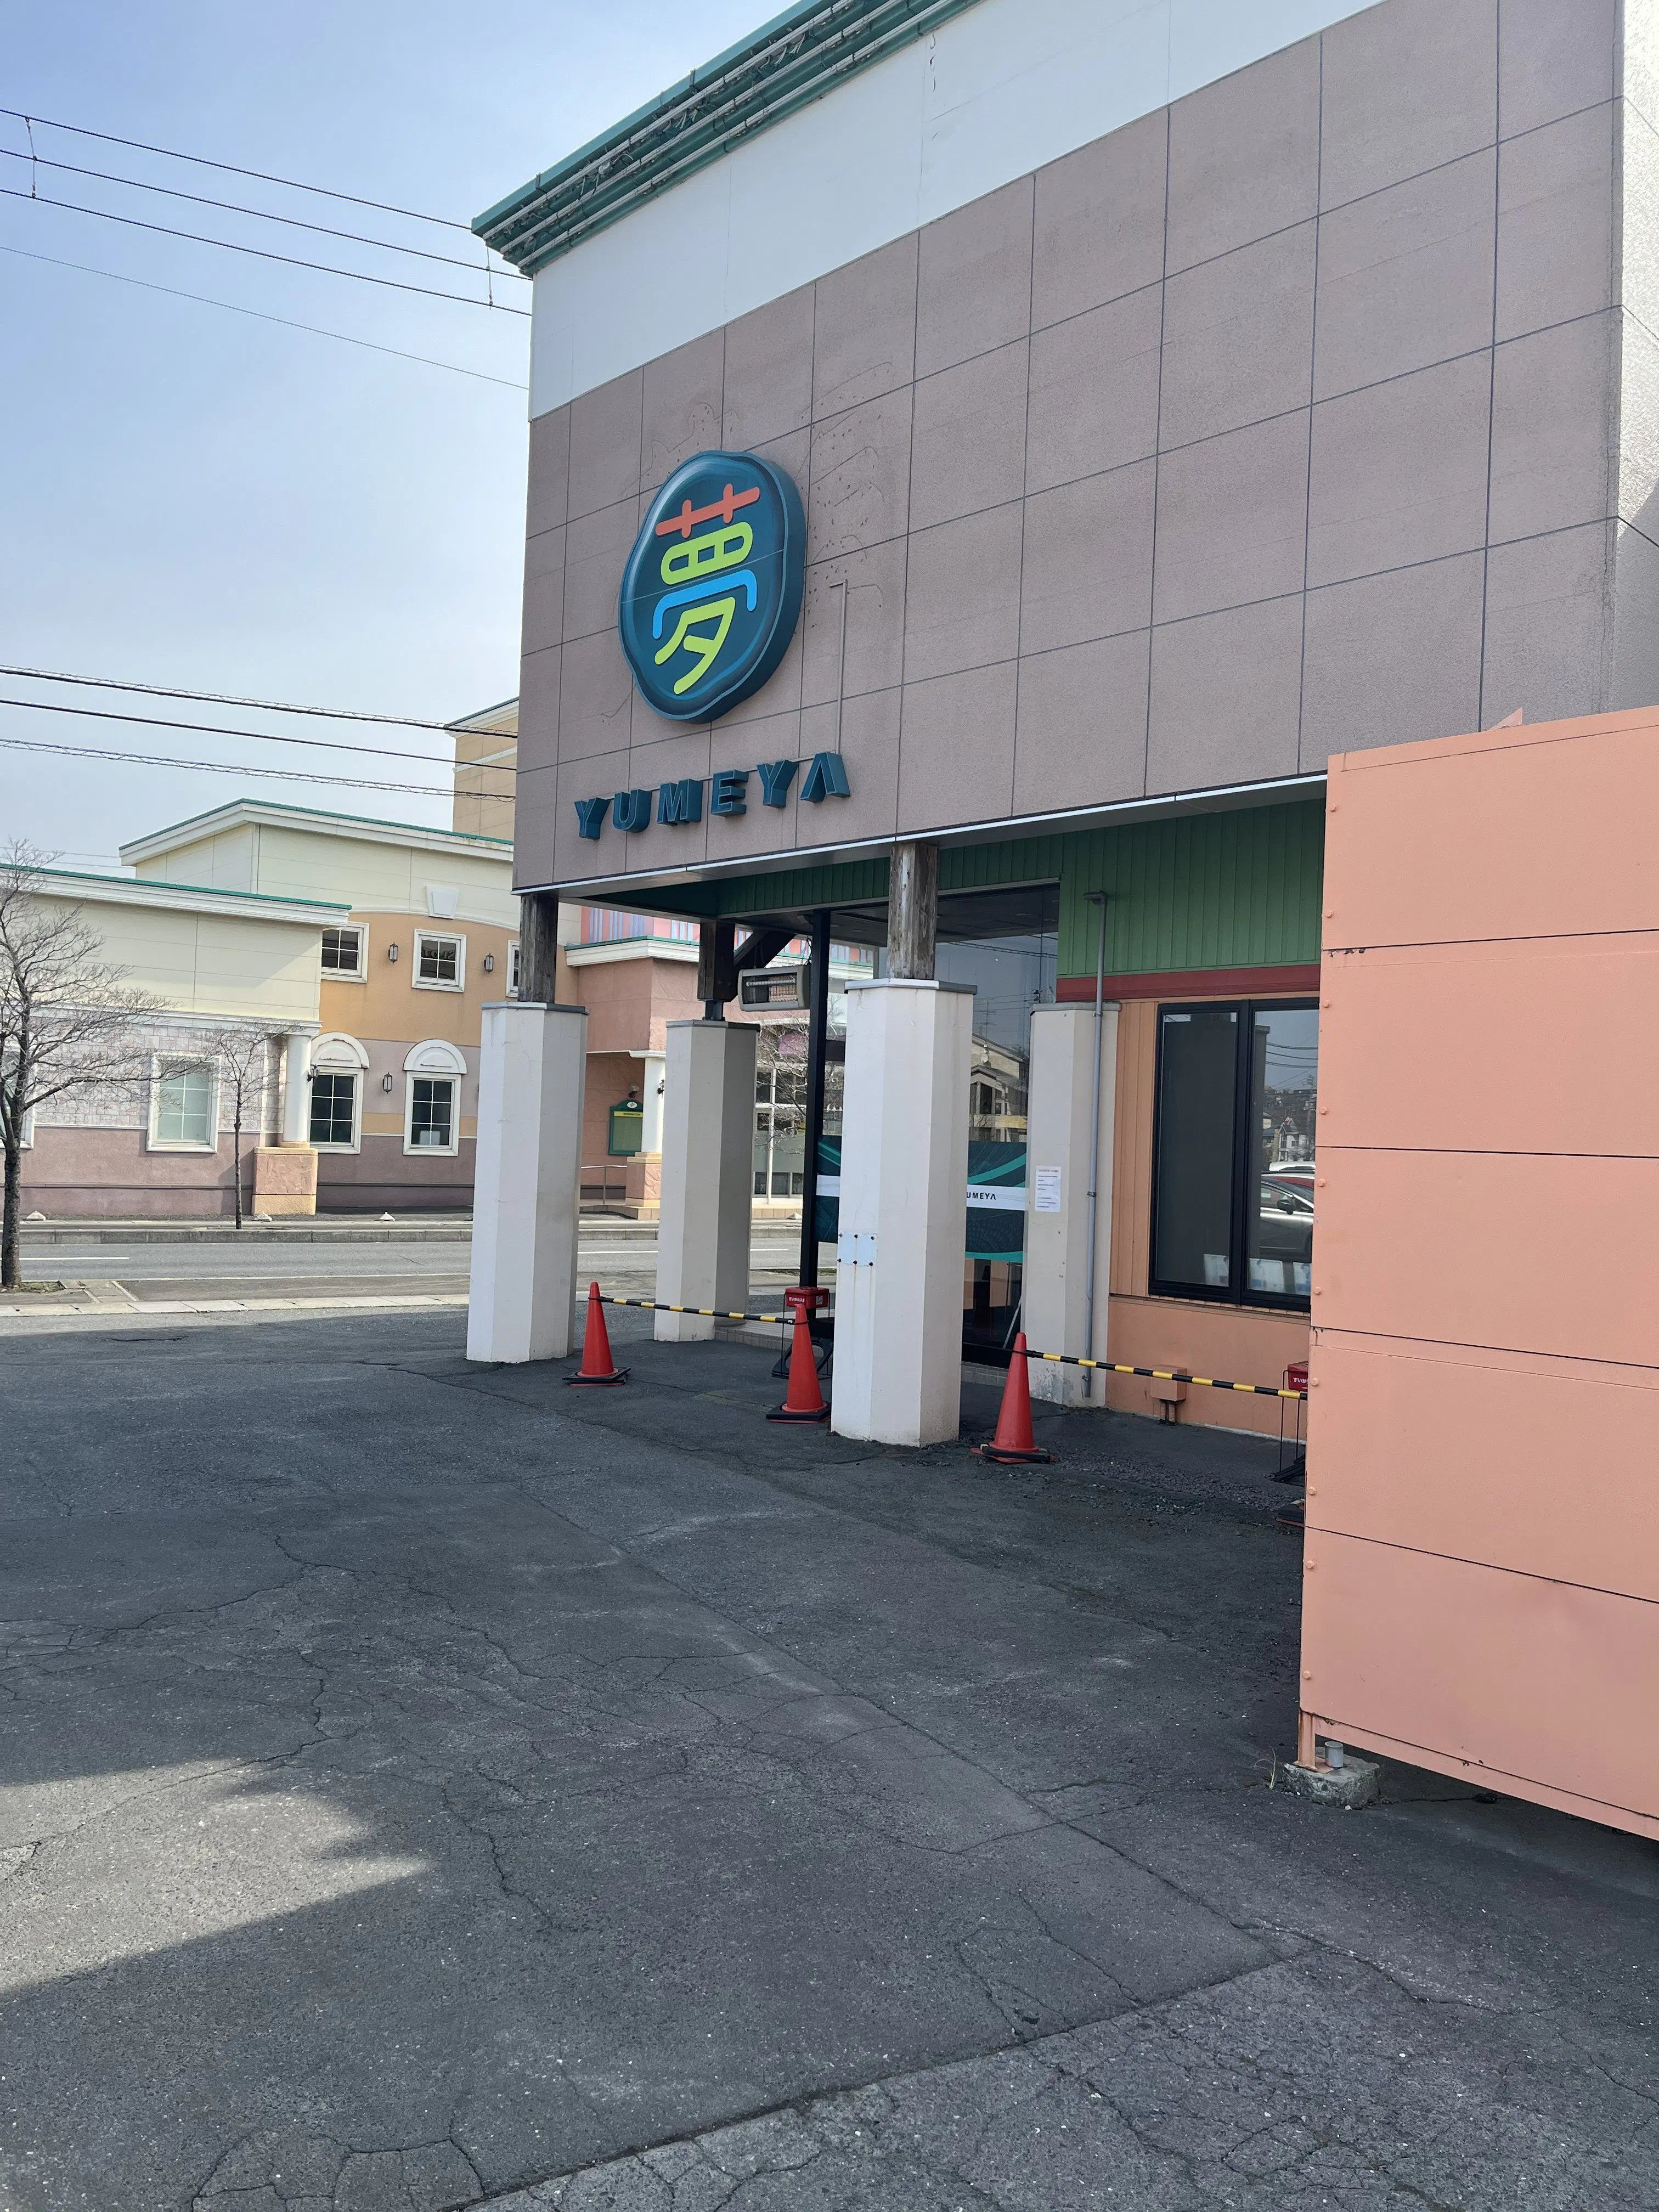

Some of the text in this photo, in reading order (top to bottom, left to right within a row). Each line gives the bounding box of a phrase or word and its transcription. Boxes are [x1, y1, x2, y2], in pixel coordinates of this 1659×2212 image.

[653, 483, 760, 695] 夢
[574, 751, 851, 840] YUMEYA
[966, 1192, 996, 1200] UMEYA
